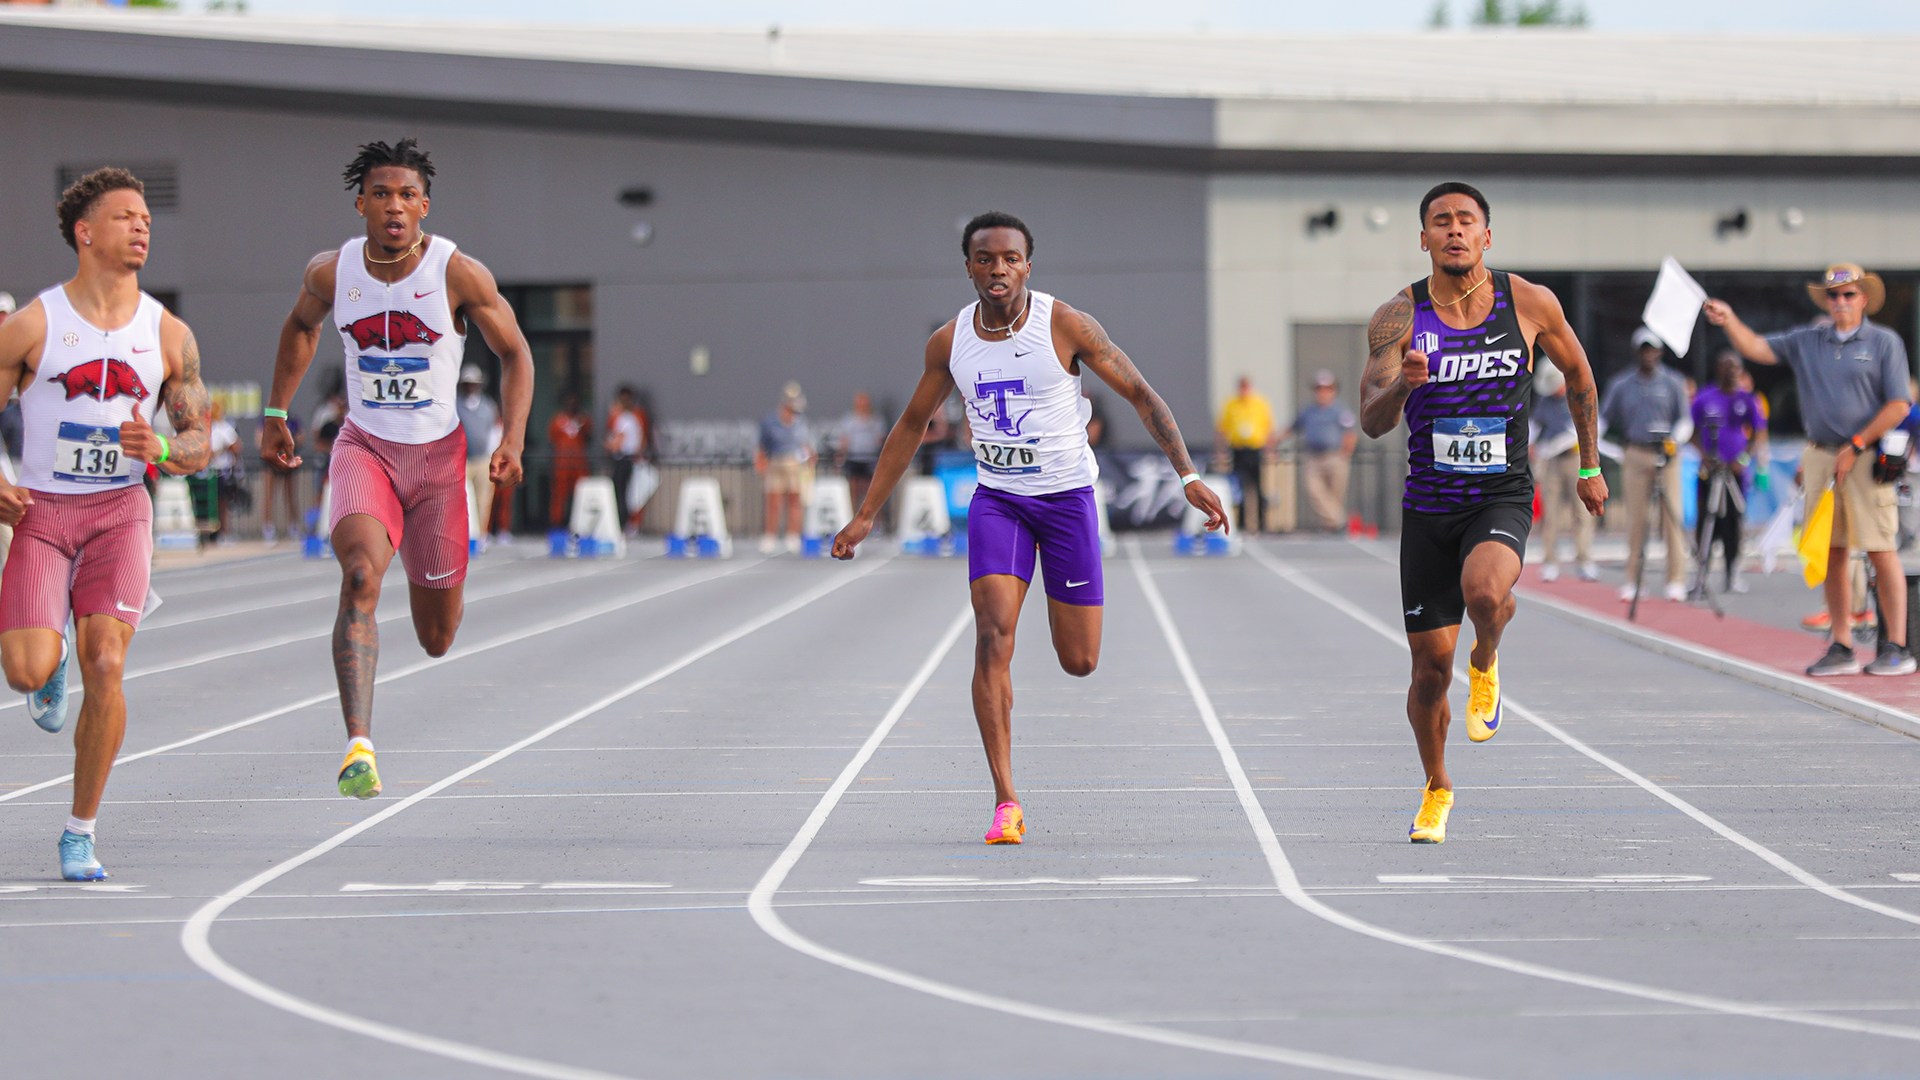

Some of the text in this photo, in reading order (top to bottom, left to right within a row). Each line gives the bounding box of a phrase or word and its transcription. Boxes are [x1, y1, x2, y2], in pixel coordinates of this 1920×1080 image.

[373, 378, 418, 401] 142
[71, 448, 119, 475] 139
[979, 443, 1034, 467] 1276
[1447, 440, 1492, 463] 448
